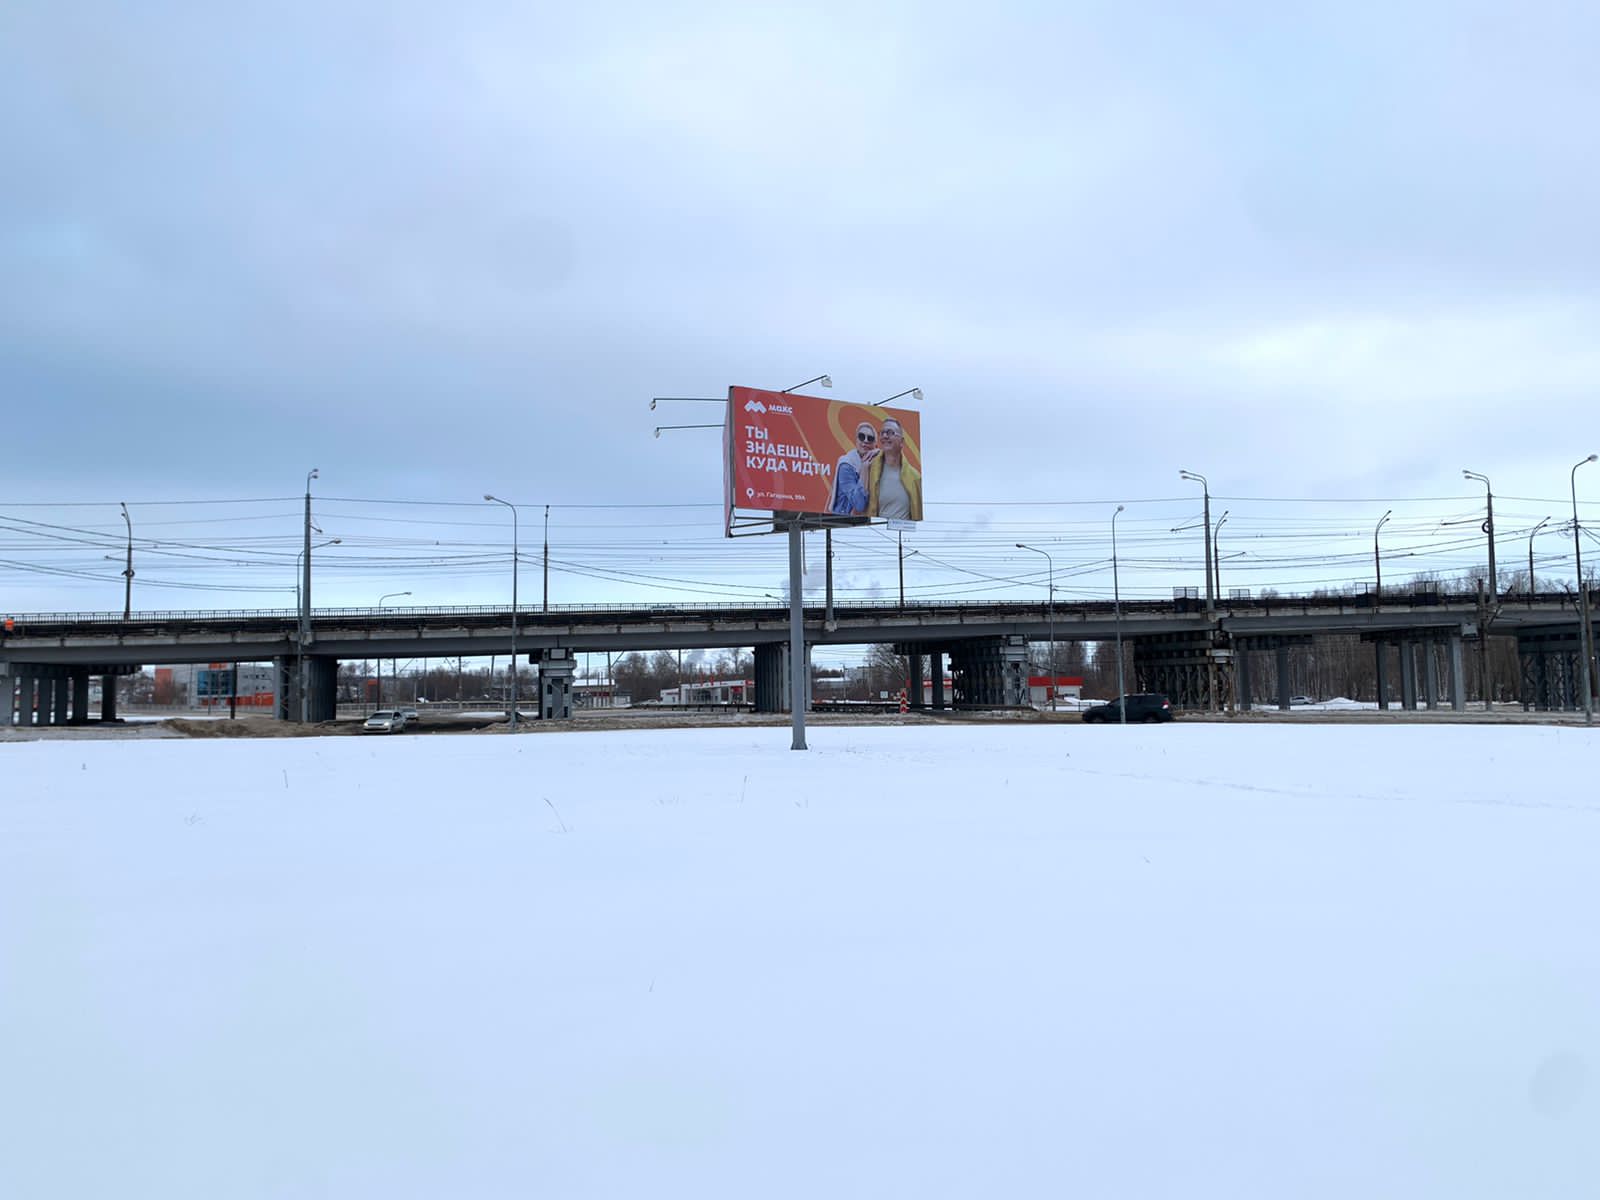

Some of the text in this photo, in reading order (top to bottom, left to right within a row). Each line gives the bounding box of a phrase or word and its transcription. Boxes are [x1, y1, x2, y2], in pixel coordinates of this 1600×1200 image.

[745, 425, 768, 440] ТЫ
[745, 440, 812, 461] ЗНАЕШЬ,
[746, 456, 831, 476] КУДА ИДТИ
